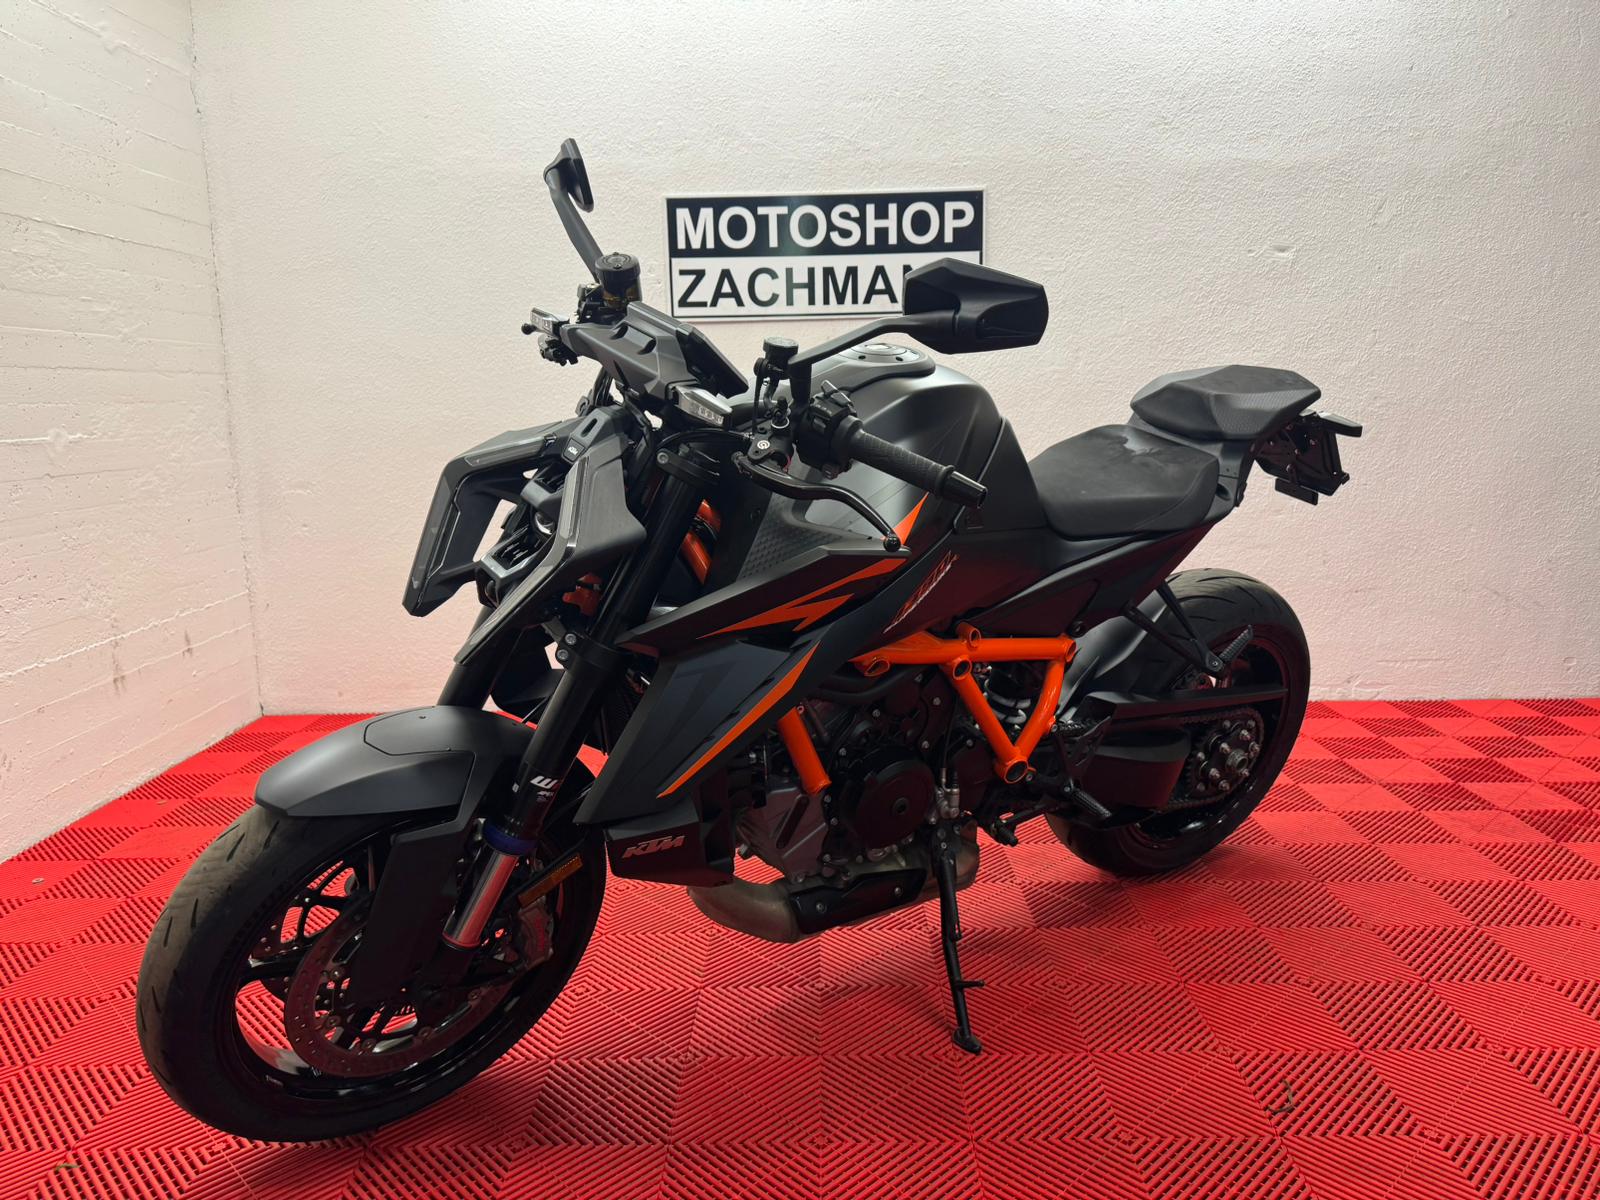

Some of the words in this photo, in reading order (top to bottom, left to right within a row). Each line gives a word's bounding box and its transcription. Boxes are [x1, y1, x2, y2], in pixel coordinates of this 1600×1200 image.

[675, 201, 975, 250] MOTOSHOP
[677, 264, 914, 308] ZACHMA
[622, 835, 685, 859] KTM
